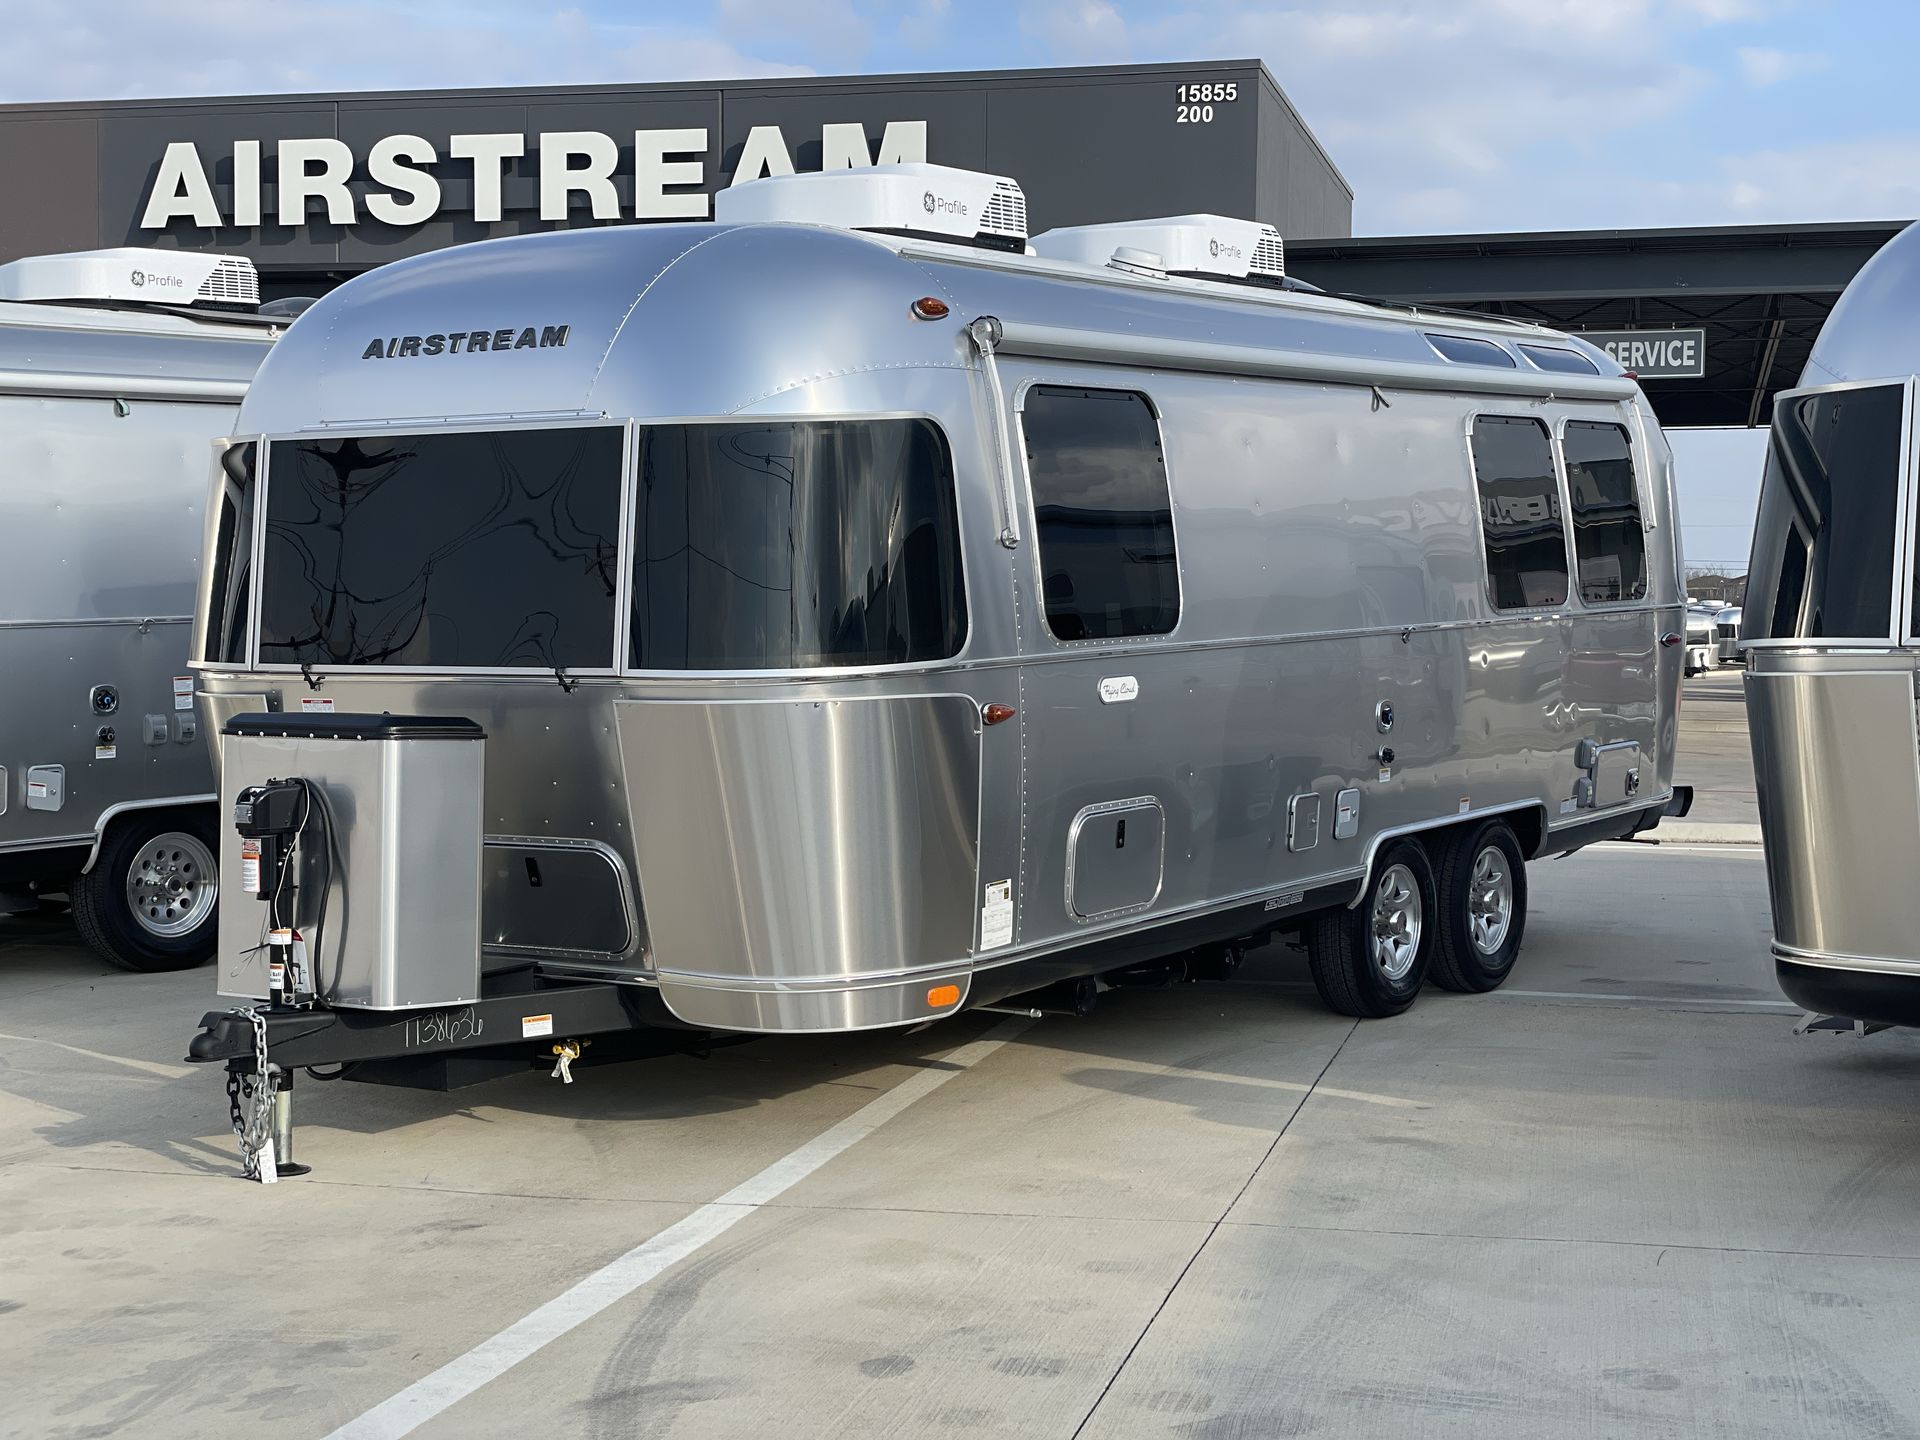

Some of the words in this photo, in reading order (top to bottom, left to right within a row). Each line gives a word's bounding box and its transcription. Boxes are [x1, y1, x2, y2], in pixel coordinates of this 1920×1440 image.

[1177, 83, 1237, 103] 15855
[1176, 105, 1214, 123] 200
[937, 197, 967, 215] Profile
[1219, 243, 1241, 258] Profile
[147, 273, 183, 288] Profile
[361, 324, 571, 360] AIRSTREAM
[1604, 340, 1695, 367] SERVICE
